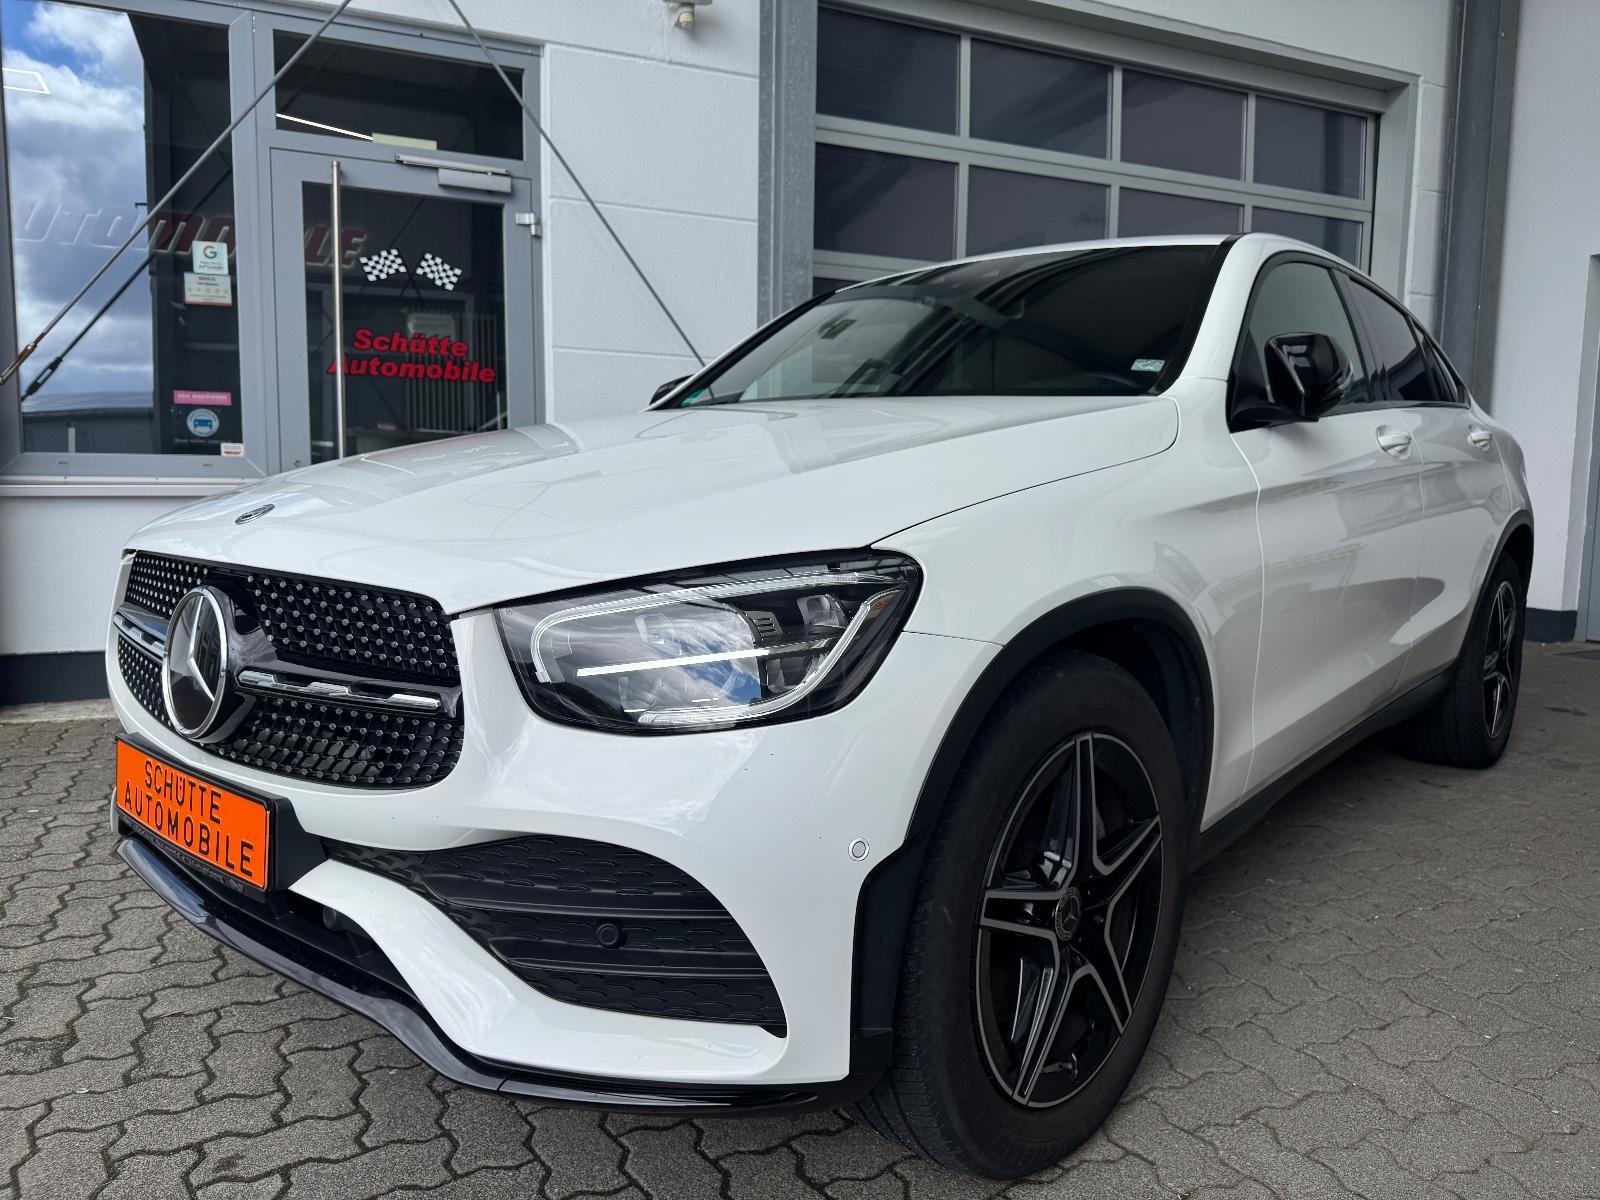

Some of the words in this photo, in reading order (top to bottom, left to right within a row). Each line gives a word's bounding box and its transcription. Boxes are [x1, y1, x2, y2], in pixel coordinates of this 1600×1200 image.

[203, 245, 217, 259] G
[353, 328, 469, 357] Schütte
[327, 352, 497, 383] Automobile
[145, 760, 222, 824] SCHÜTTE
[125, 780, 254, 877] AUTOMOBILE
